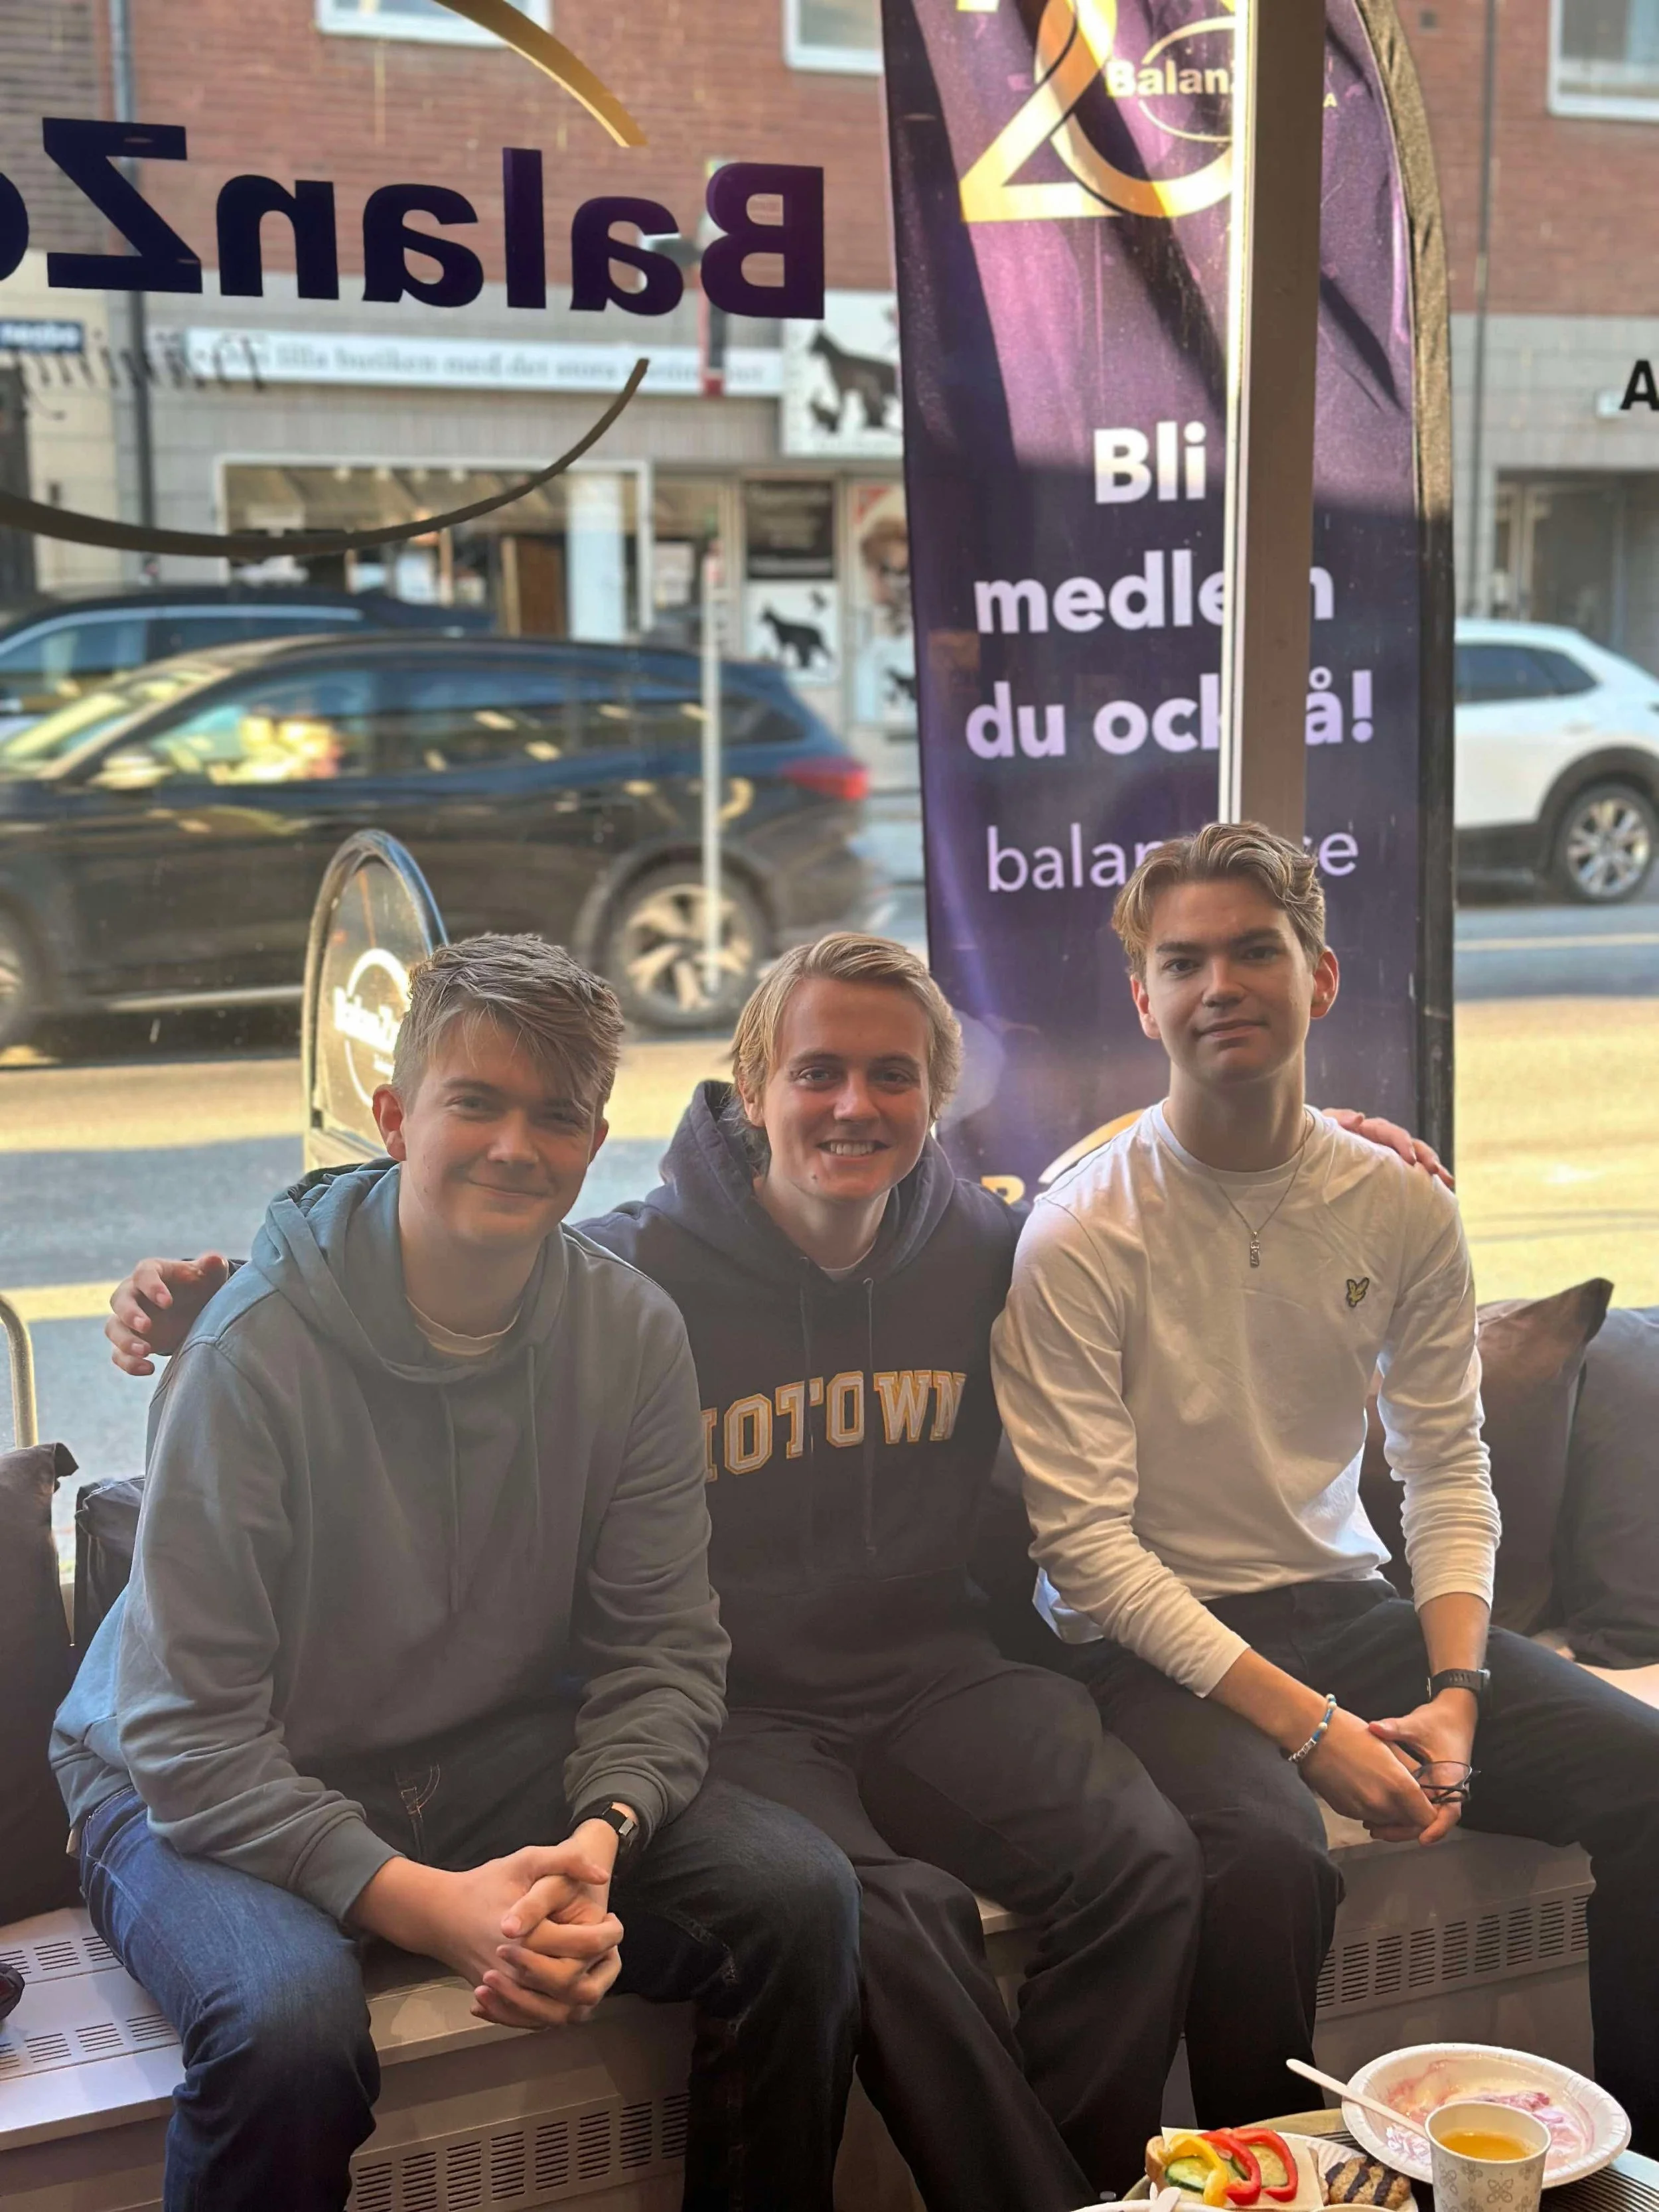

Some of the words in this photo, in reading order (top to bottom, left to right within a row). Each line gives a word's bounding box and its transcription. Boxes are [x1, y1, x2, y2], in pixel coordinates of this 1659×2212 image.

[1106, 58, 1236, 98] Balan
[1094, 421, 1206, 504] Bli
[966, 682, 1066, 758] du
[1093, 666, 1374, 755] ocå!
[701, 1369, 968, 1483] OTOWN
